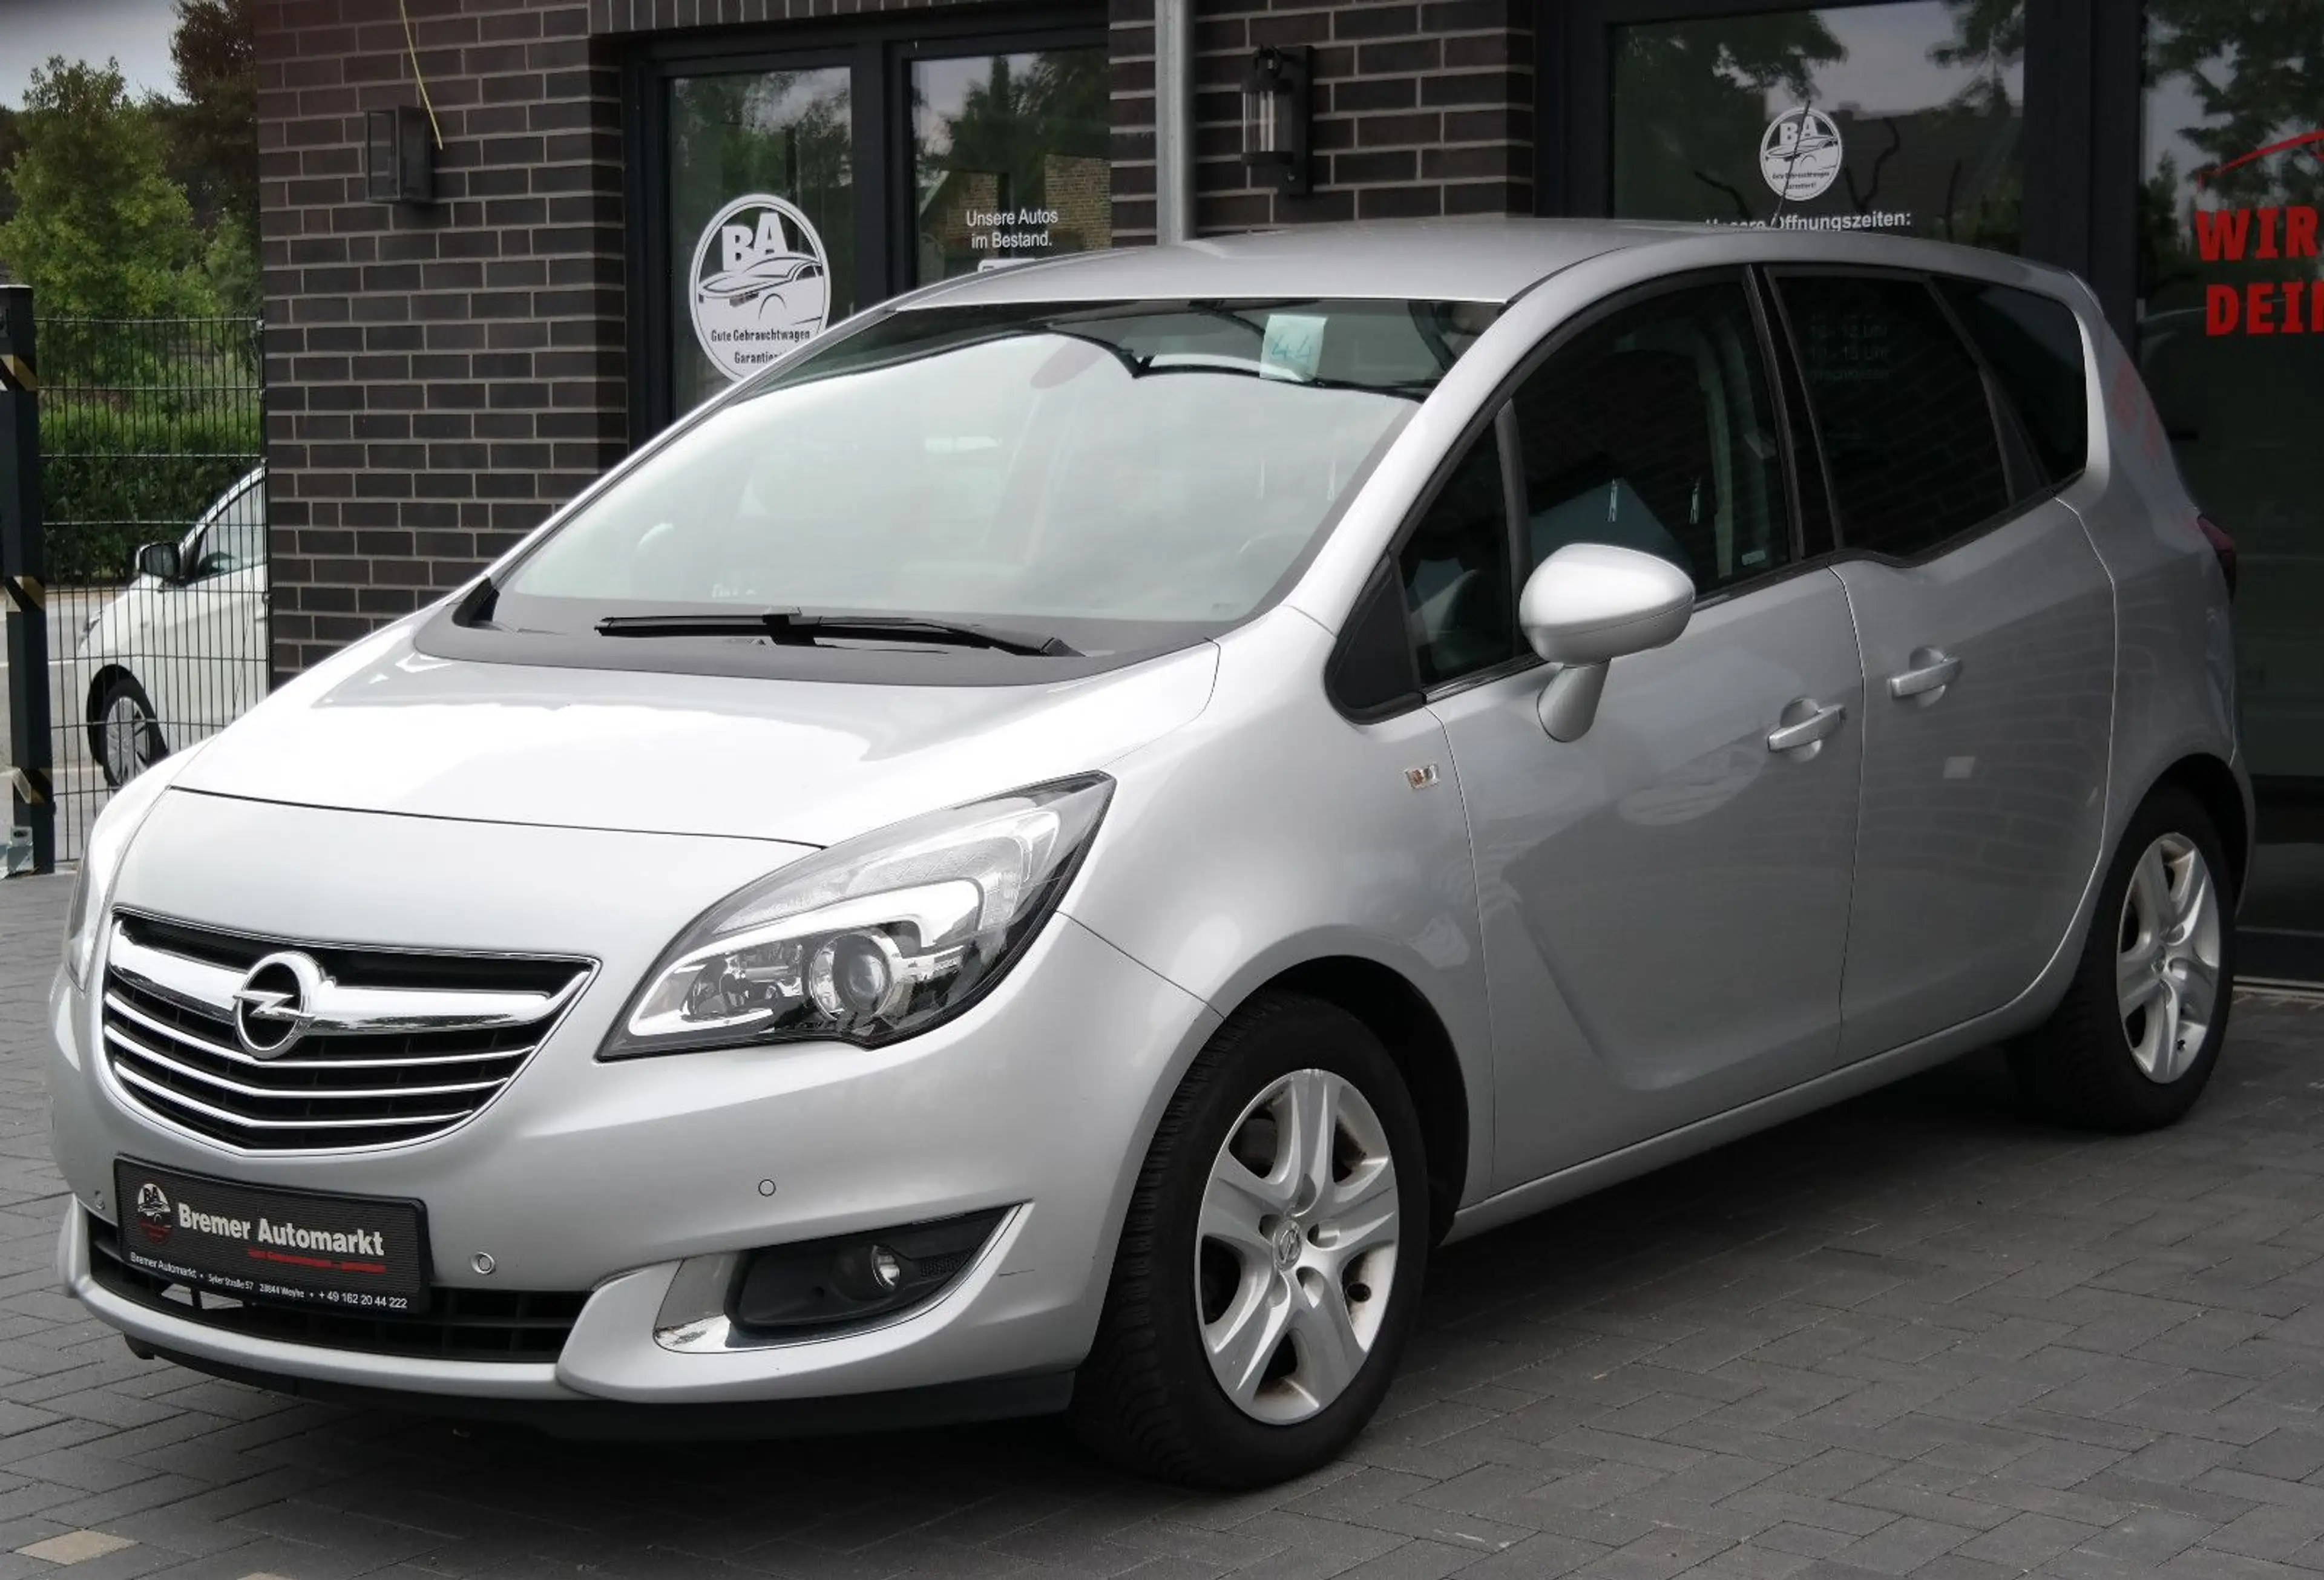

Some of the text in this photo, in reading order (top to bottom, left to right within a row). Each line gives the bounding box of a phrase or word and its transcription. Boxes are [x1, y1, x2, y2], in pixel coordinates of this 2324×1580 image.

[1780, 116, 1817, 145] BA
[967, 208, 1059, 226] Unsere Autos
[2195, 205, 2318, 261] WIR
[722, 213, 788, 271] BA
[971, 231, 1052, 249] im Bestand.
[711, 329, 810, 343] Gute Gebrauchtwagen
[178, 1202, 251, 1239] Bremer
[258, 1218, 385, 1256] Automarkt
[130, 1251, 157, 1268] Bremer
[245, 1280, 254, 1291] 57
[327, 1291, 340, 1302] 49
[343, 1293, 358, 1304] 162
[361, 1295, 373, 1305] 20
[375, 1296, 387, 1307] 44
[389, 1297, 408, 1309] 222
